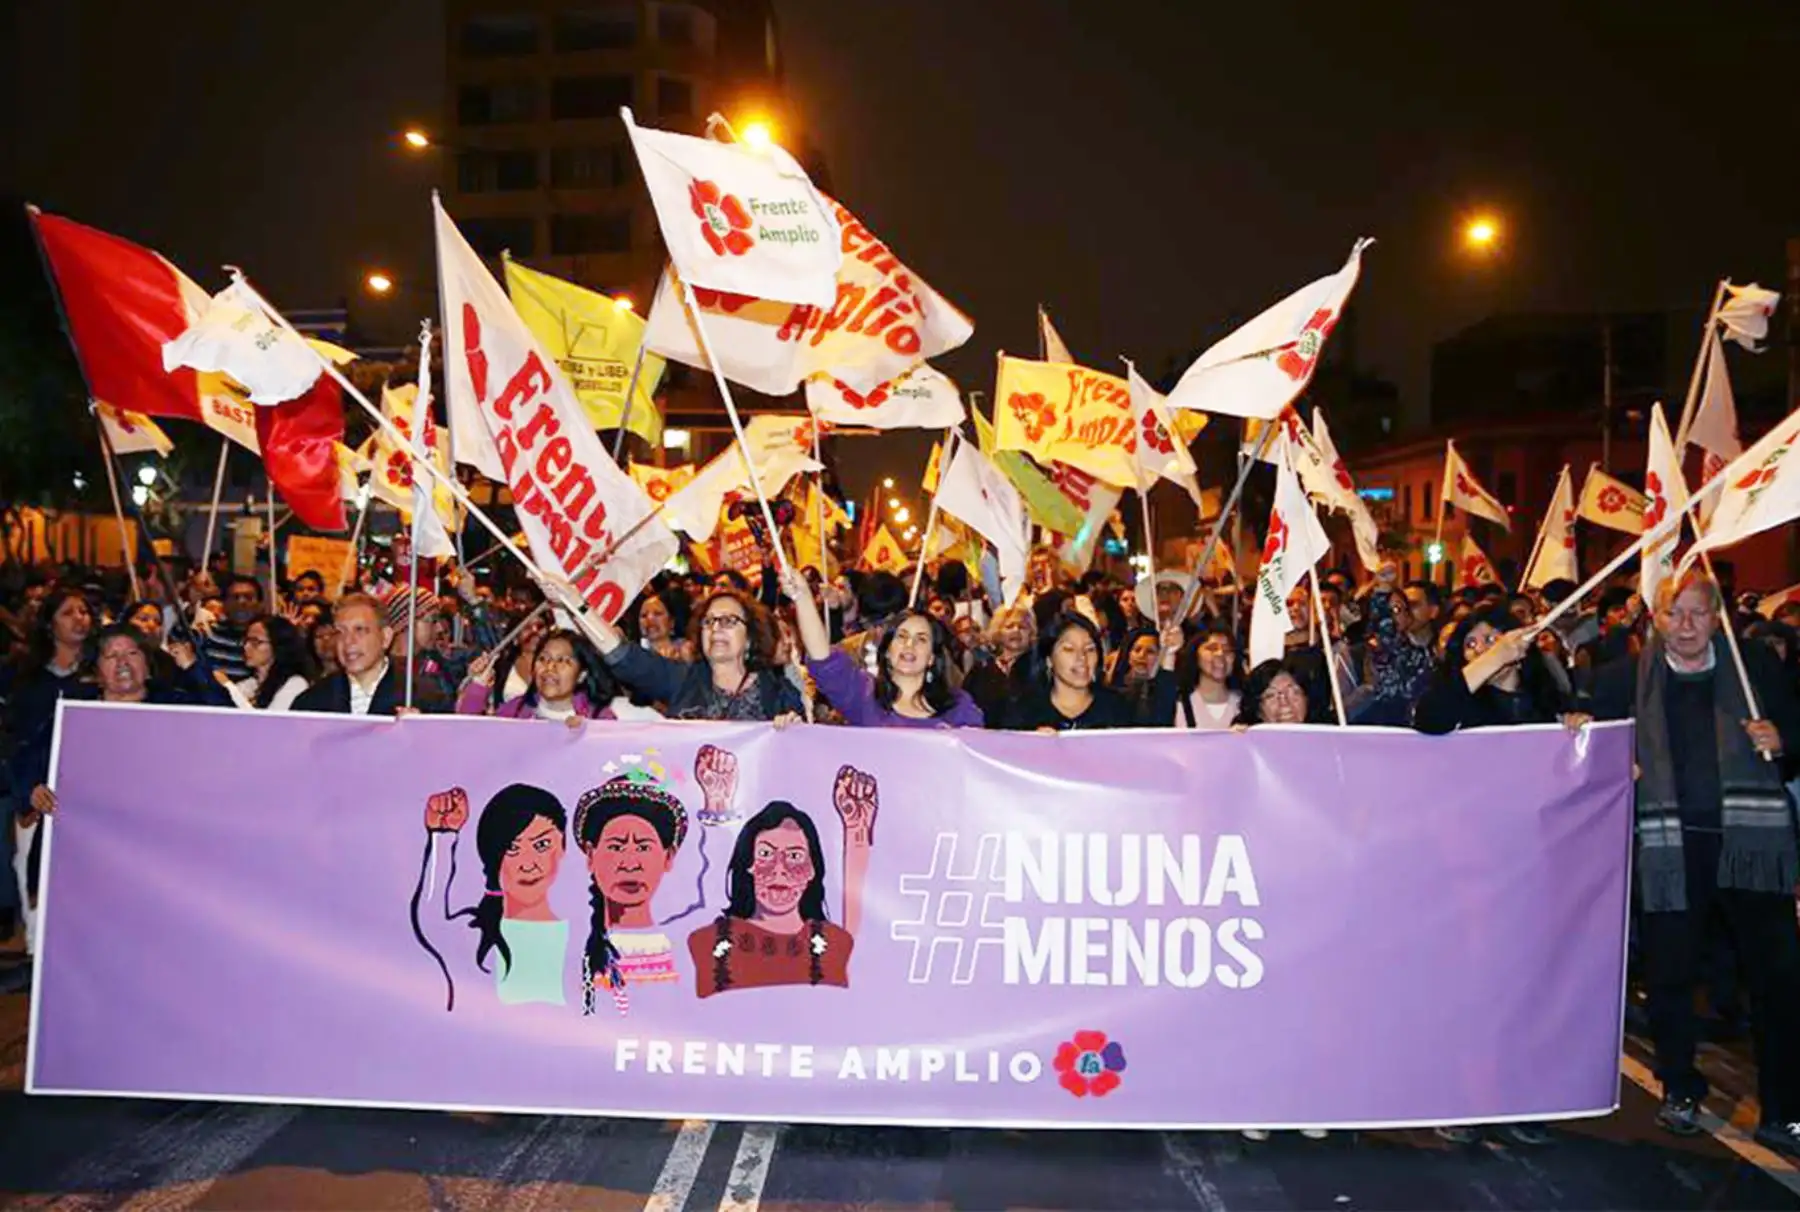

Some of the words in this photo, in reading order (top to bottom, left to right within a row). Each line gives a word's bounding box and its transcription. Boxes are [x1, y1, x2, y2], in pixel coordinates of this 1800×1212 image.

[748, 197, 808, 216] Frente
[759, 223, 820, 247] Amplio
[1003, 916, 1265, 988] MENOS
[615, 1040, 814, 1078] FRENTE
[838, 1046, 1043, 1084] AMPLIO
